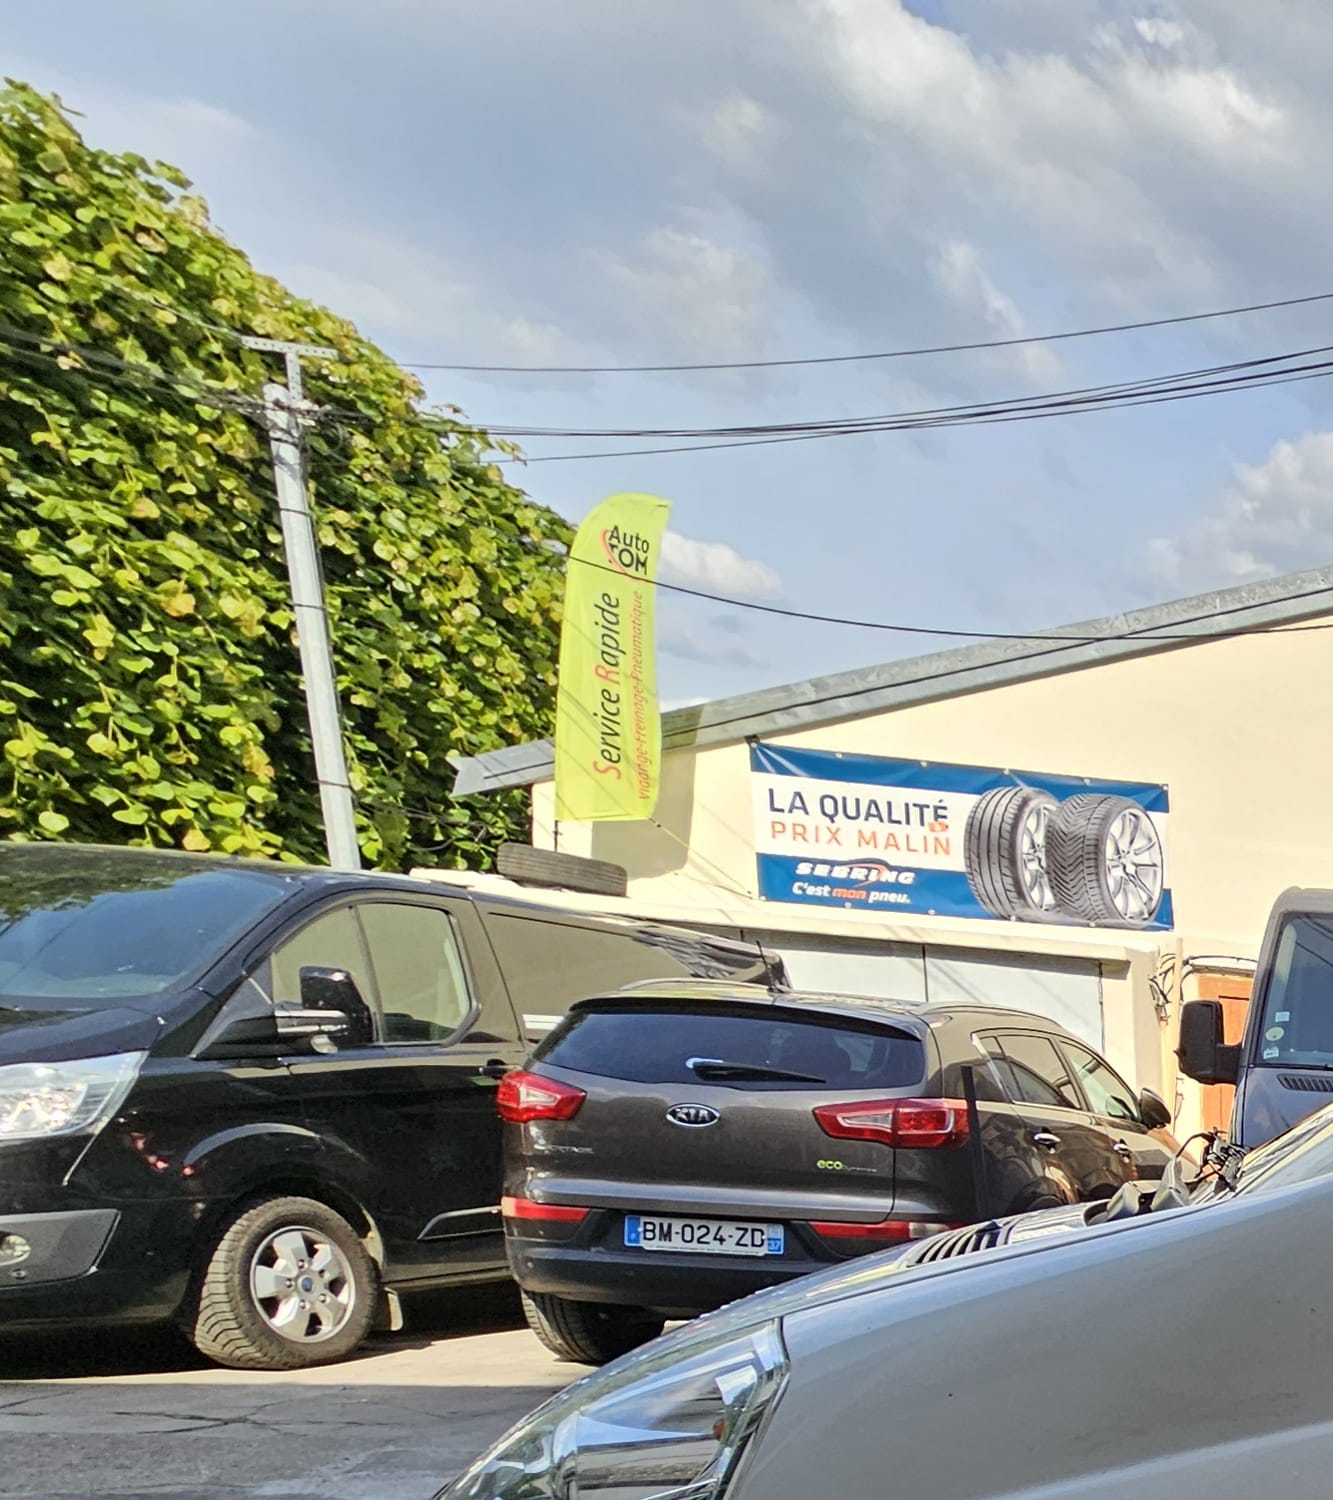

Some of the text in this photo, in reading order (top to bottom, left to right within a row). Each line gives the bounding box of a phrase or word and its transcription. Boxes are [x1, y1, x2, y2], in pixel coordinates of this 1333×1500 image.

[608, 524, 650, 554] Auto
[592, 592, 627, 780] Service Rapide
[768, 788, 949, 829] LA QUALITÉ
[770, 820, 951, 856] PRIX MALIN
[795, 862, 916, 885] SEBRING
[792, 881, 913, 904] C'est mon pneu.
[816, 1160, 843, 1170] eco
[642, 1221, 765, 1248] BM-024-ZD
[768, 1240, 780, 1250] 37
